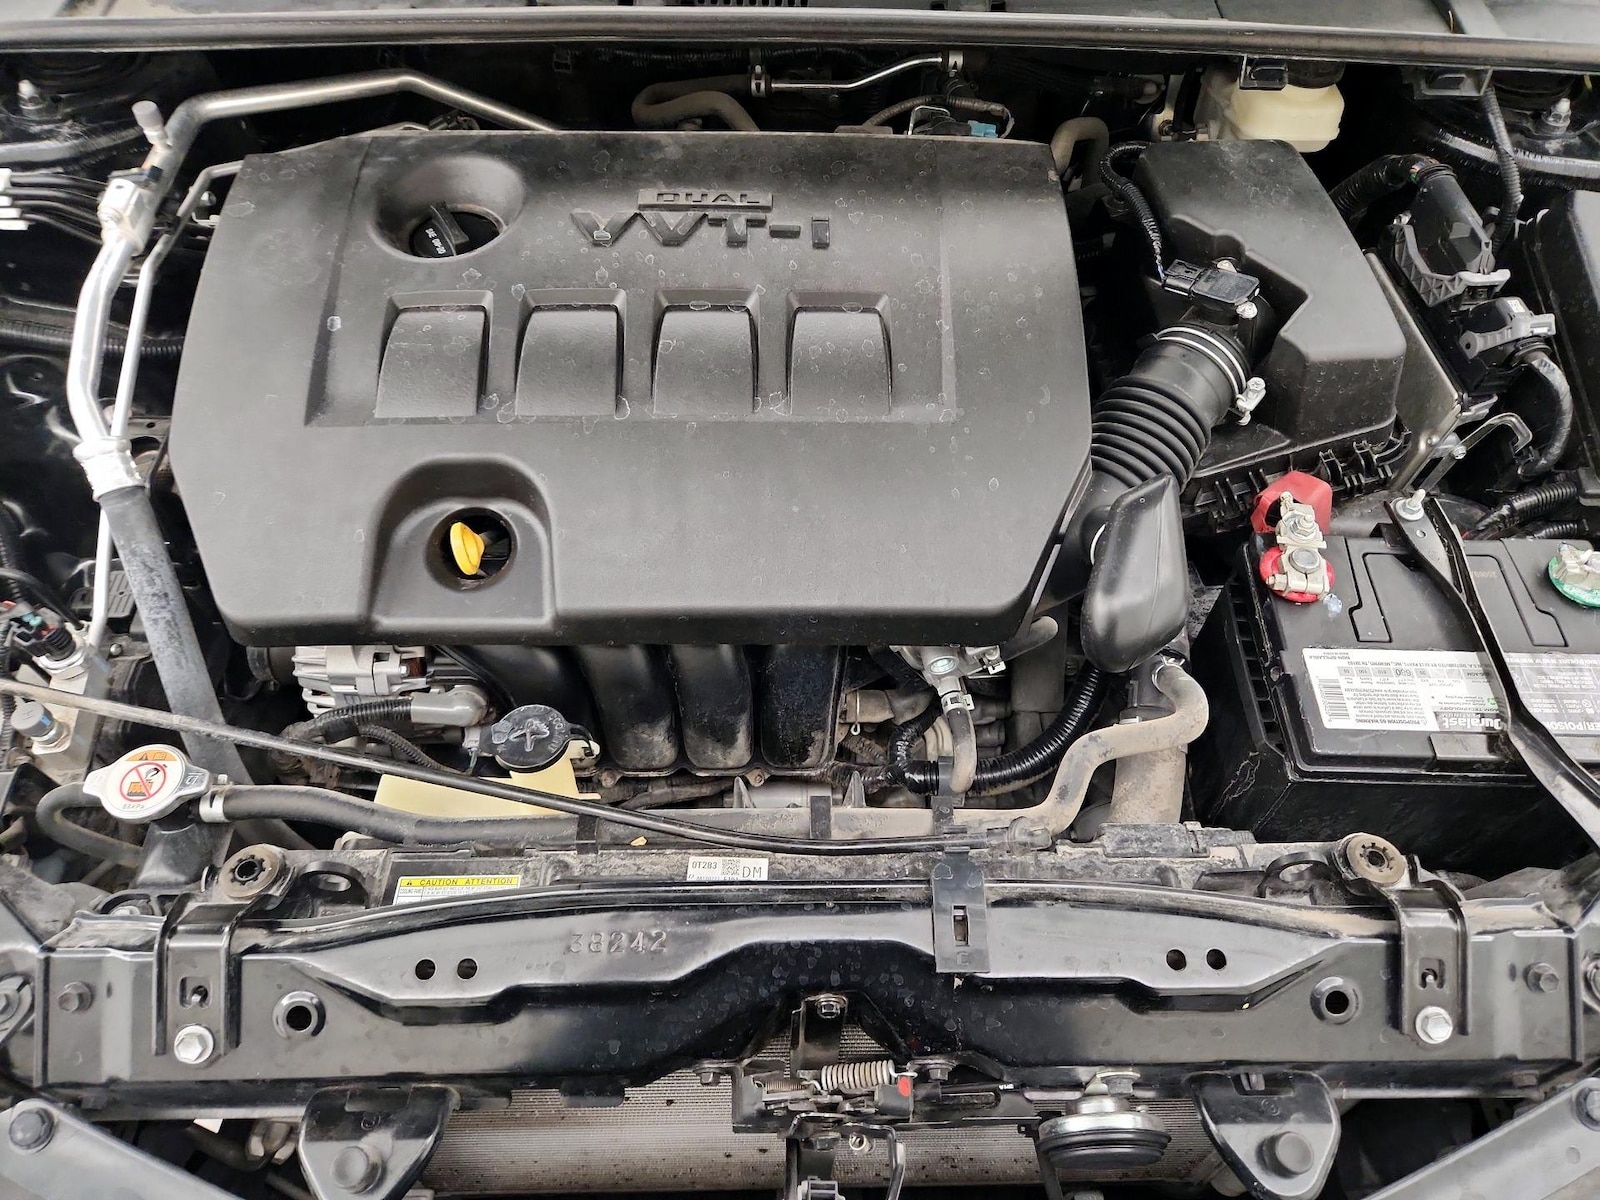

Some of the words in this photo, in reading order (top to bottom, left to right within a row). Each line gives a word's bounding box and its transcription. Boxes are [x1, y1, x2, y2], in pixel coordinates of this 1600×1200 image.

[657, 192, 760, 204] DUAL
[425, 228, 437, 239] SAE
[742, 866, 762, 878] DM
[464, 877, 513, 885] ATTENTION
[569, 929, 668, 953] 38242
